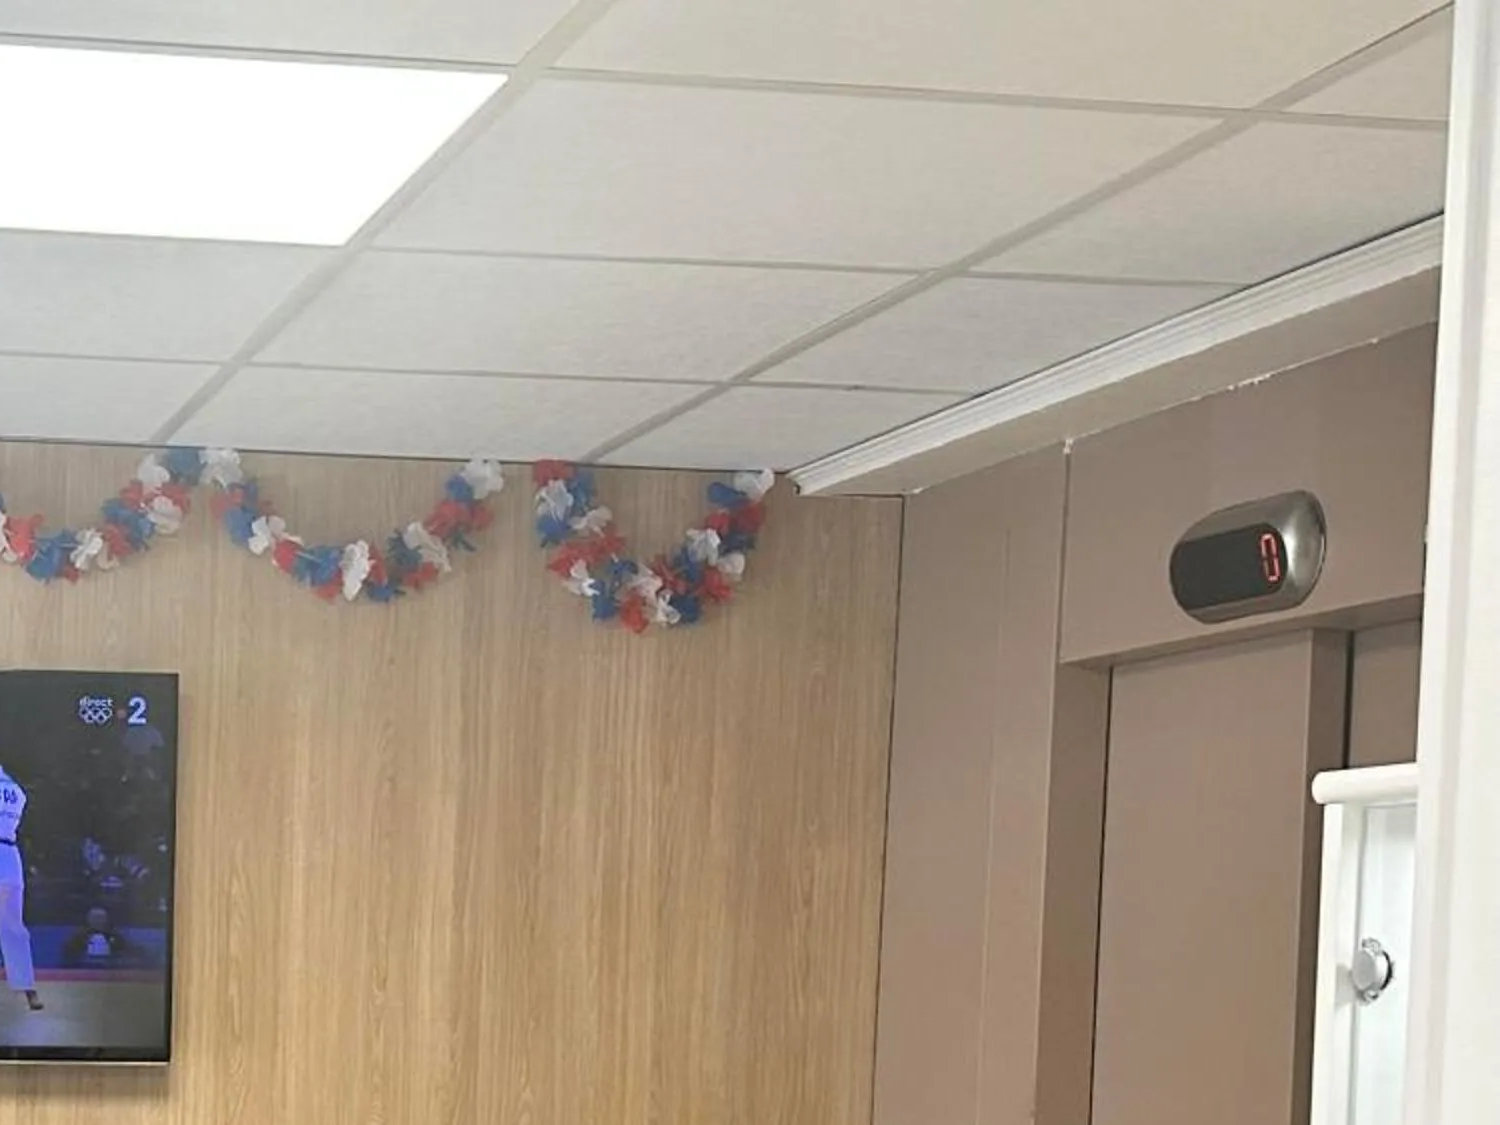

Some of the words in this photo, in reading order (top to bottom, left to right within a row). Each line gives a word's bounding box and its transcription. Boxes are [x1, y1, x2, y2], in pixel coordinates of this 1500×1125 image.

[1261, 533, 1280, 581] 0
[79, 696, 113, 708] direct
[128, 697, 147, 724] 2
